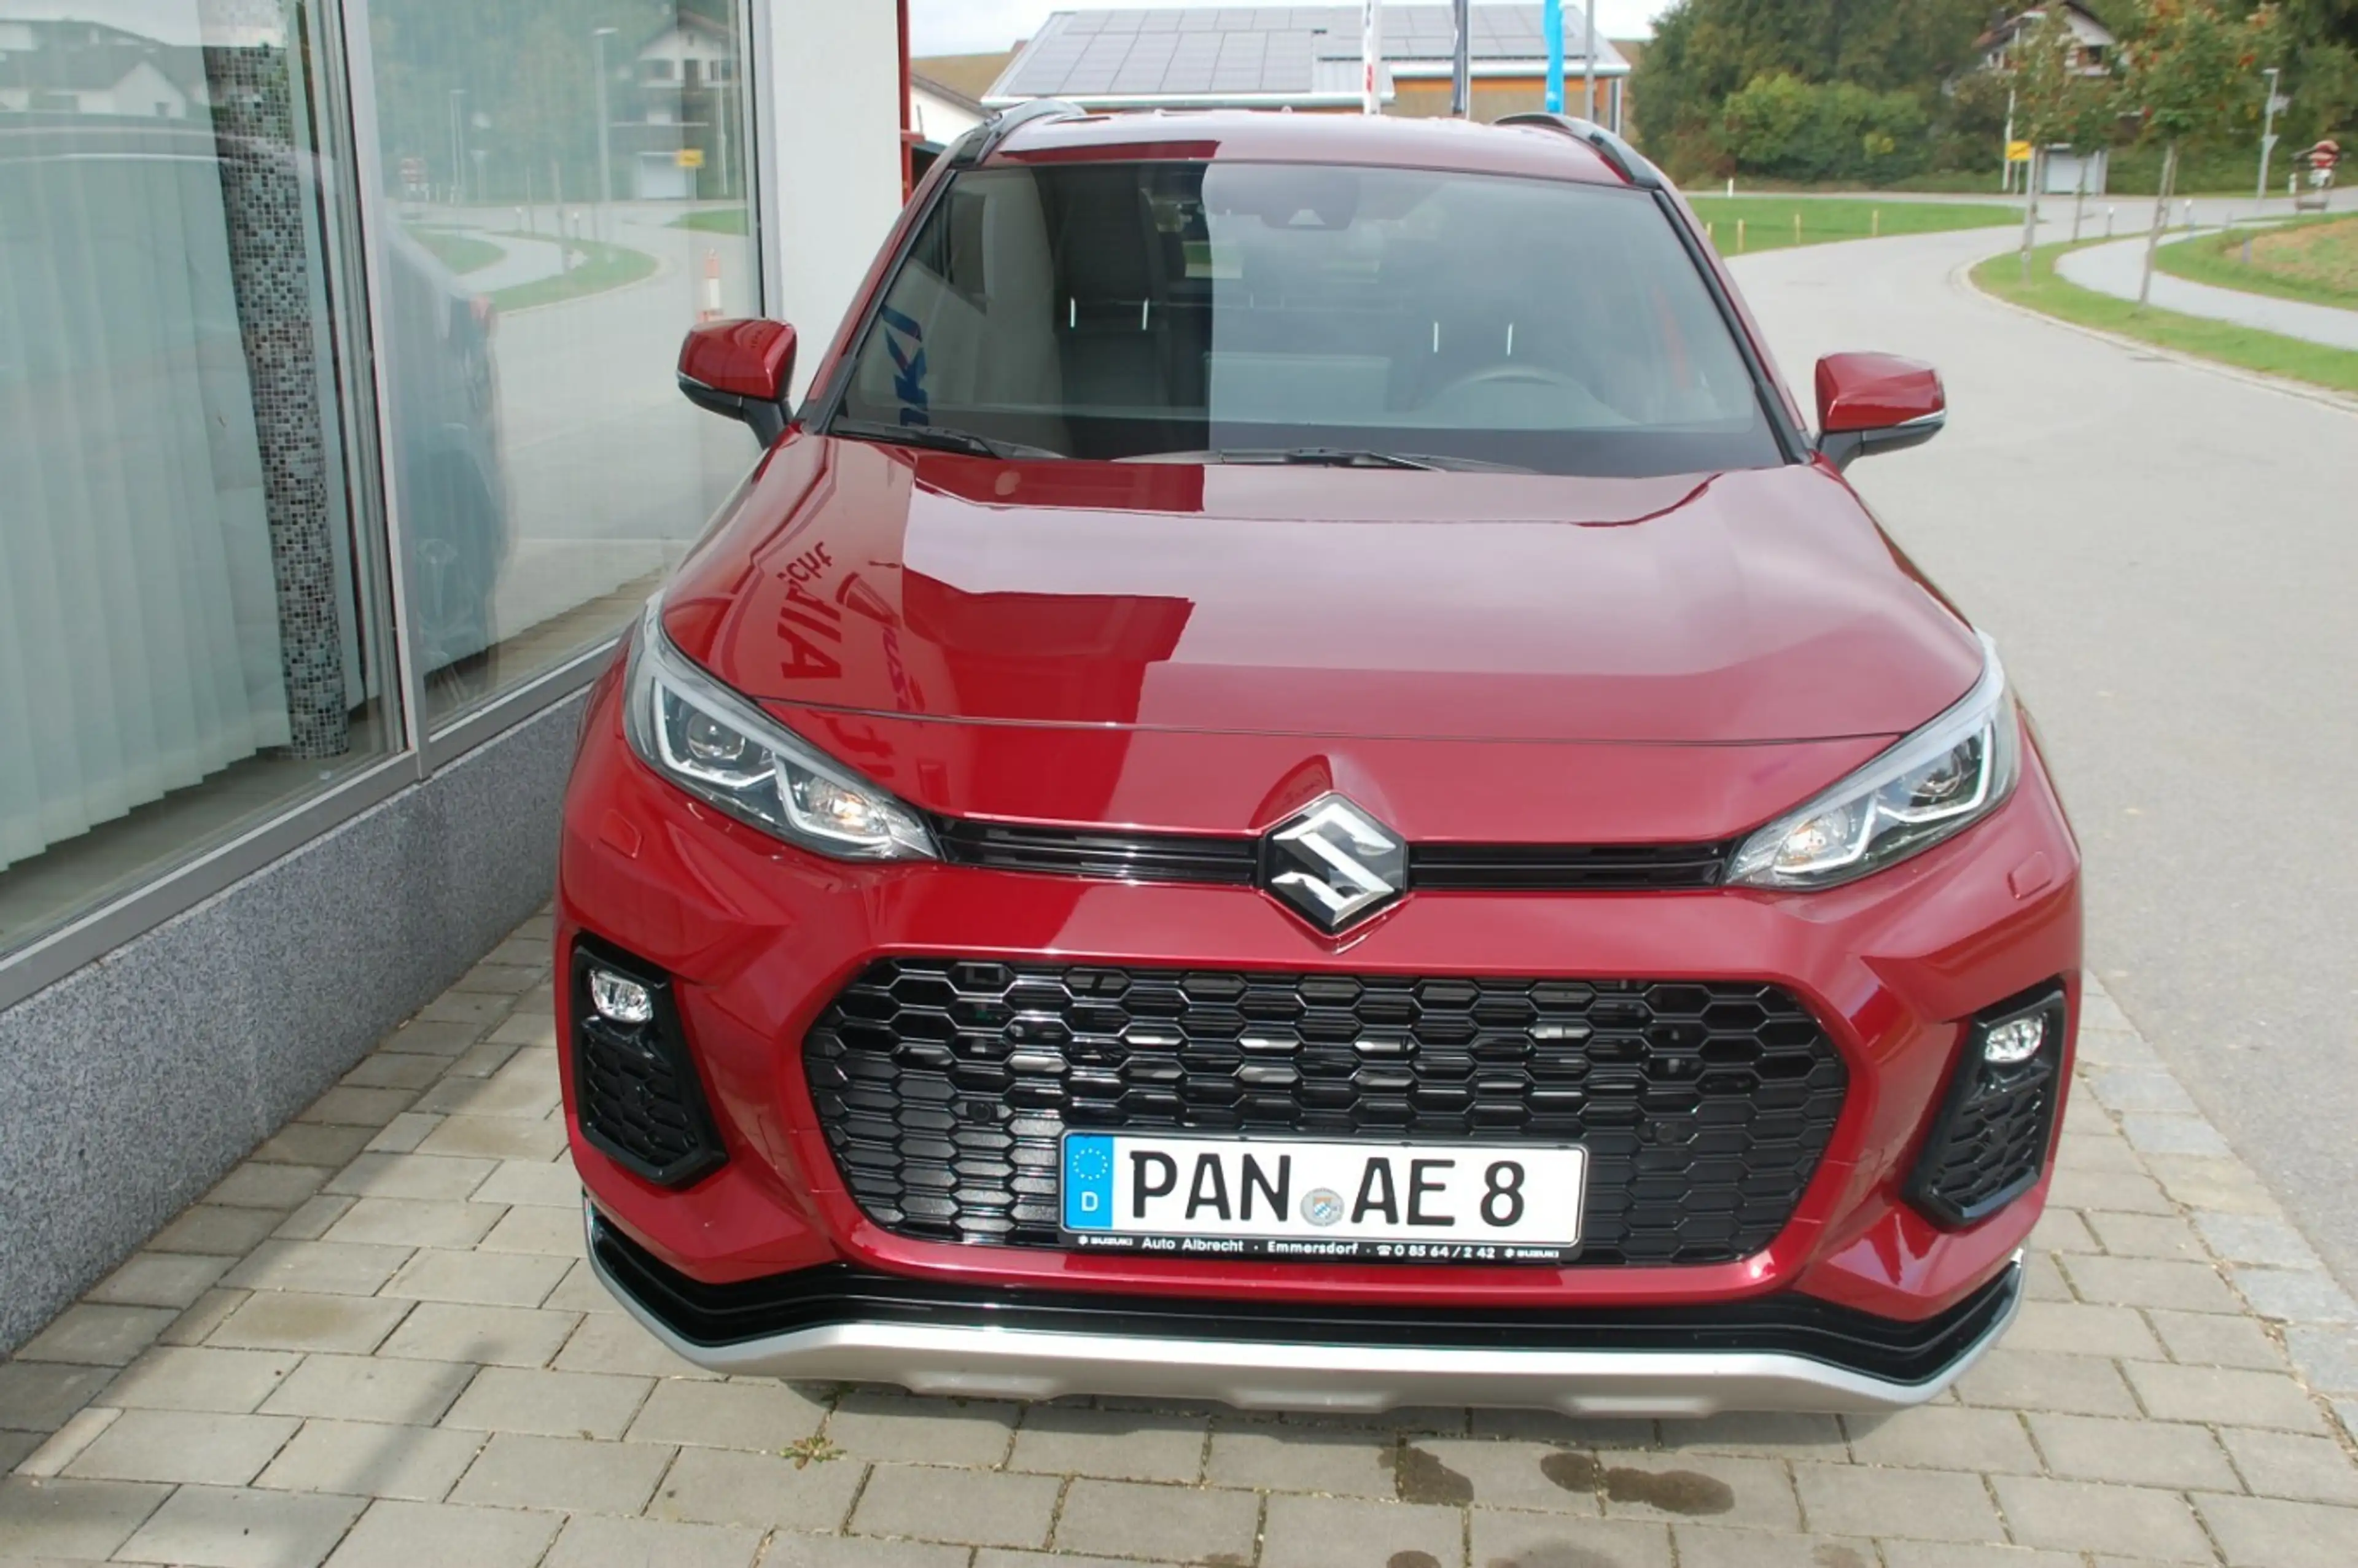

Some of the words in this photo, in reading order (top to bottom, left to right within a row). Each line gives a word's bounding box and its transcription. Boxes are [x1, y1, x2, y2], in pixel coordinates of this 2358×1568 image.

[1130, 1150, 1291, 1222] PAN
[1351, 1157, 1455, 1227] AE
[1480, 1160, 1525, 1227] 8
[1081, 1191, 1099, 1212] D
[1142, 1236, 1176, 1250] Auto
[1181, 1238, 1244, 1252] Albrecht
[1267, 1240, 1359, 1255] Emmersdorf
[1408, 1245, 1426, 1257] 85
